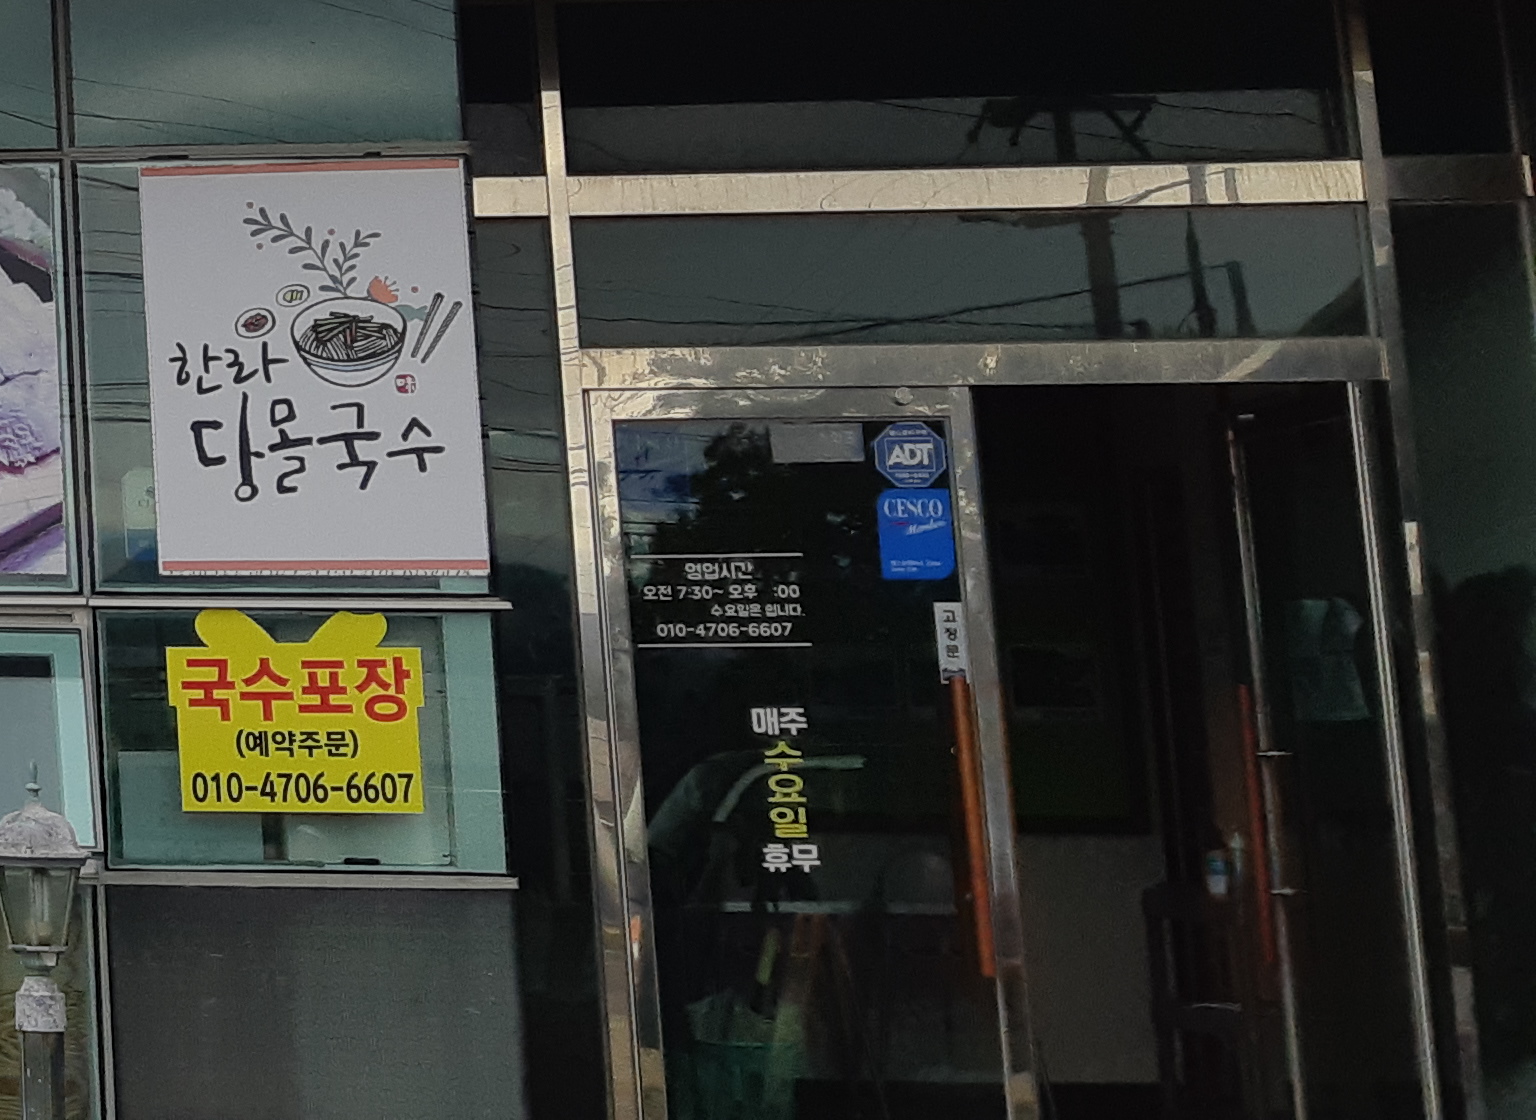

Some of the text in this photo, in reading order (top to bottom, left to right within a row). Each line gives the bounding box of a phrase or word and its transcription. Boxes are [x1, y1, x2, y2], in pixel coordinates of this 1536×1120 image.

[169, 341, 289, 395] 한라
[190, 391, 446, 502] 당몰국수
[888, 442, 934, 466] ADT
[883, 498, 943, 518] CESCO
[684, 561, 755, 580] 영업시간
[643, 585, 673, 601] 오전
[729, 583, 758, 599] 오후
[656, 622, 793, 638] 010-4706-6607
[942, 609, 960, 659] 고정문
[181, 656, 412, 722] 국수포장
[750, 707, 809, 736] 매주
[235, 729, 360, 759] (예약주문)
[191, 771, 415, 804] 010-4706-6607
[763, 741, 809, 839] 수요일
[761, 843, 821, 873] 휴무
